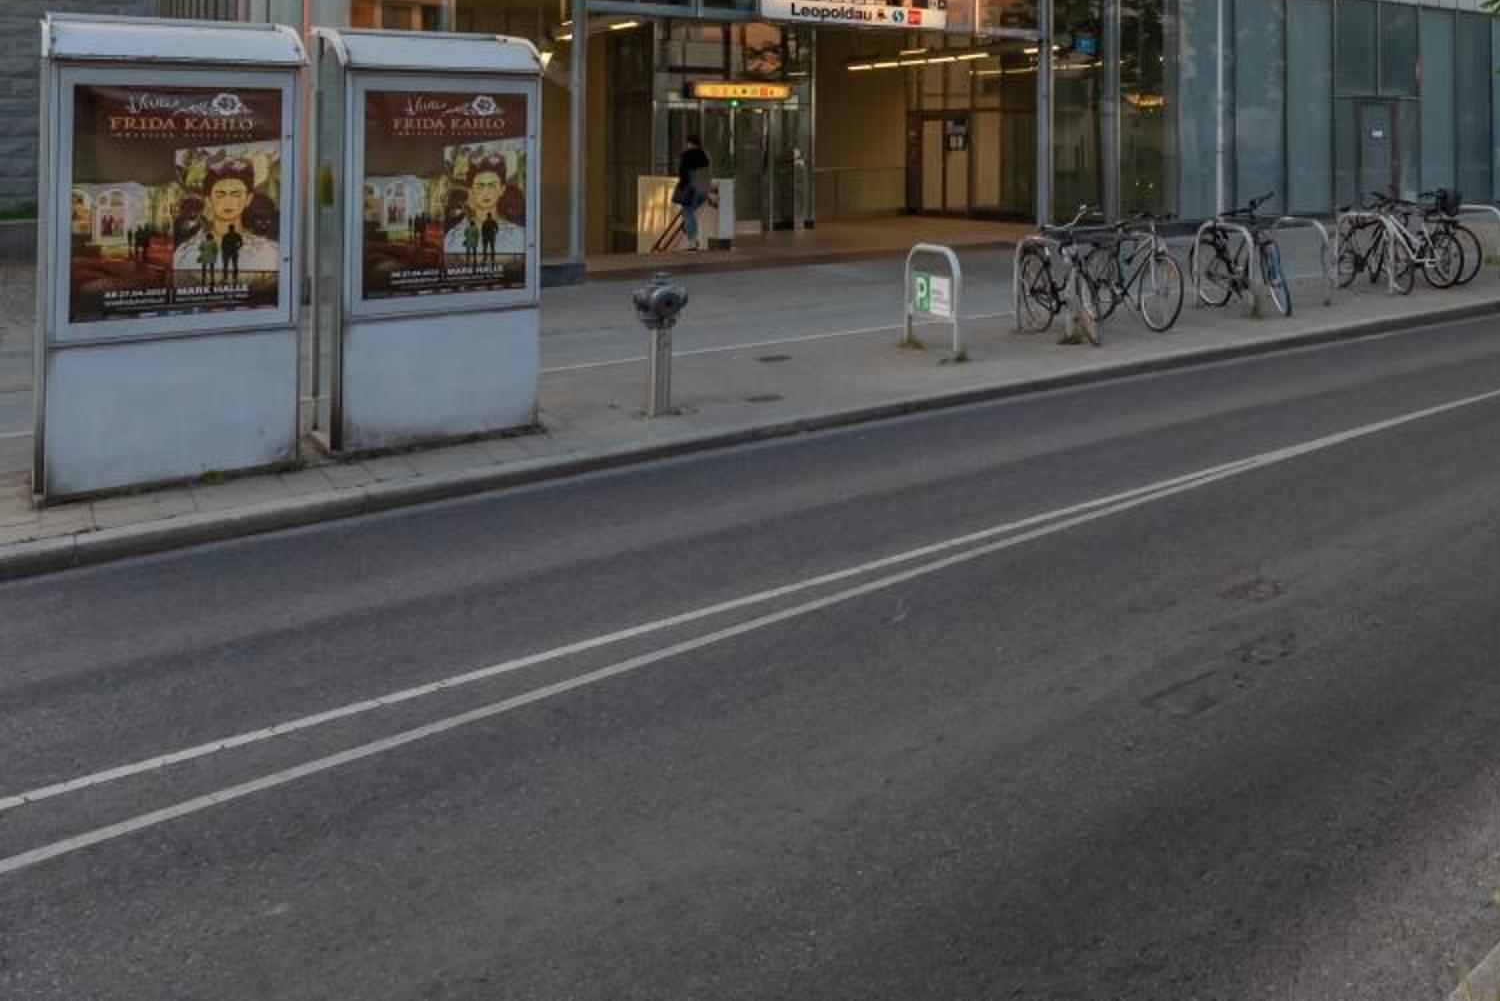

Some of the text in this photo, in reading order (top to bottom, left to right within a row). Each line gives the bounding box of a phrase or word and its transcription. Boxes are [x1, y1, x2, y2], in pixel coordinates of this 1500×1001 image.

[791, 2, 872, 22] Leopoldau
[110, 117, 254, 131] FRIDA KAHLO
[392, 118, 505, 130] FRIDA KAHLO
